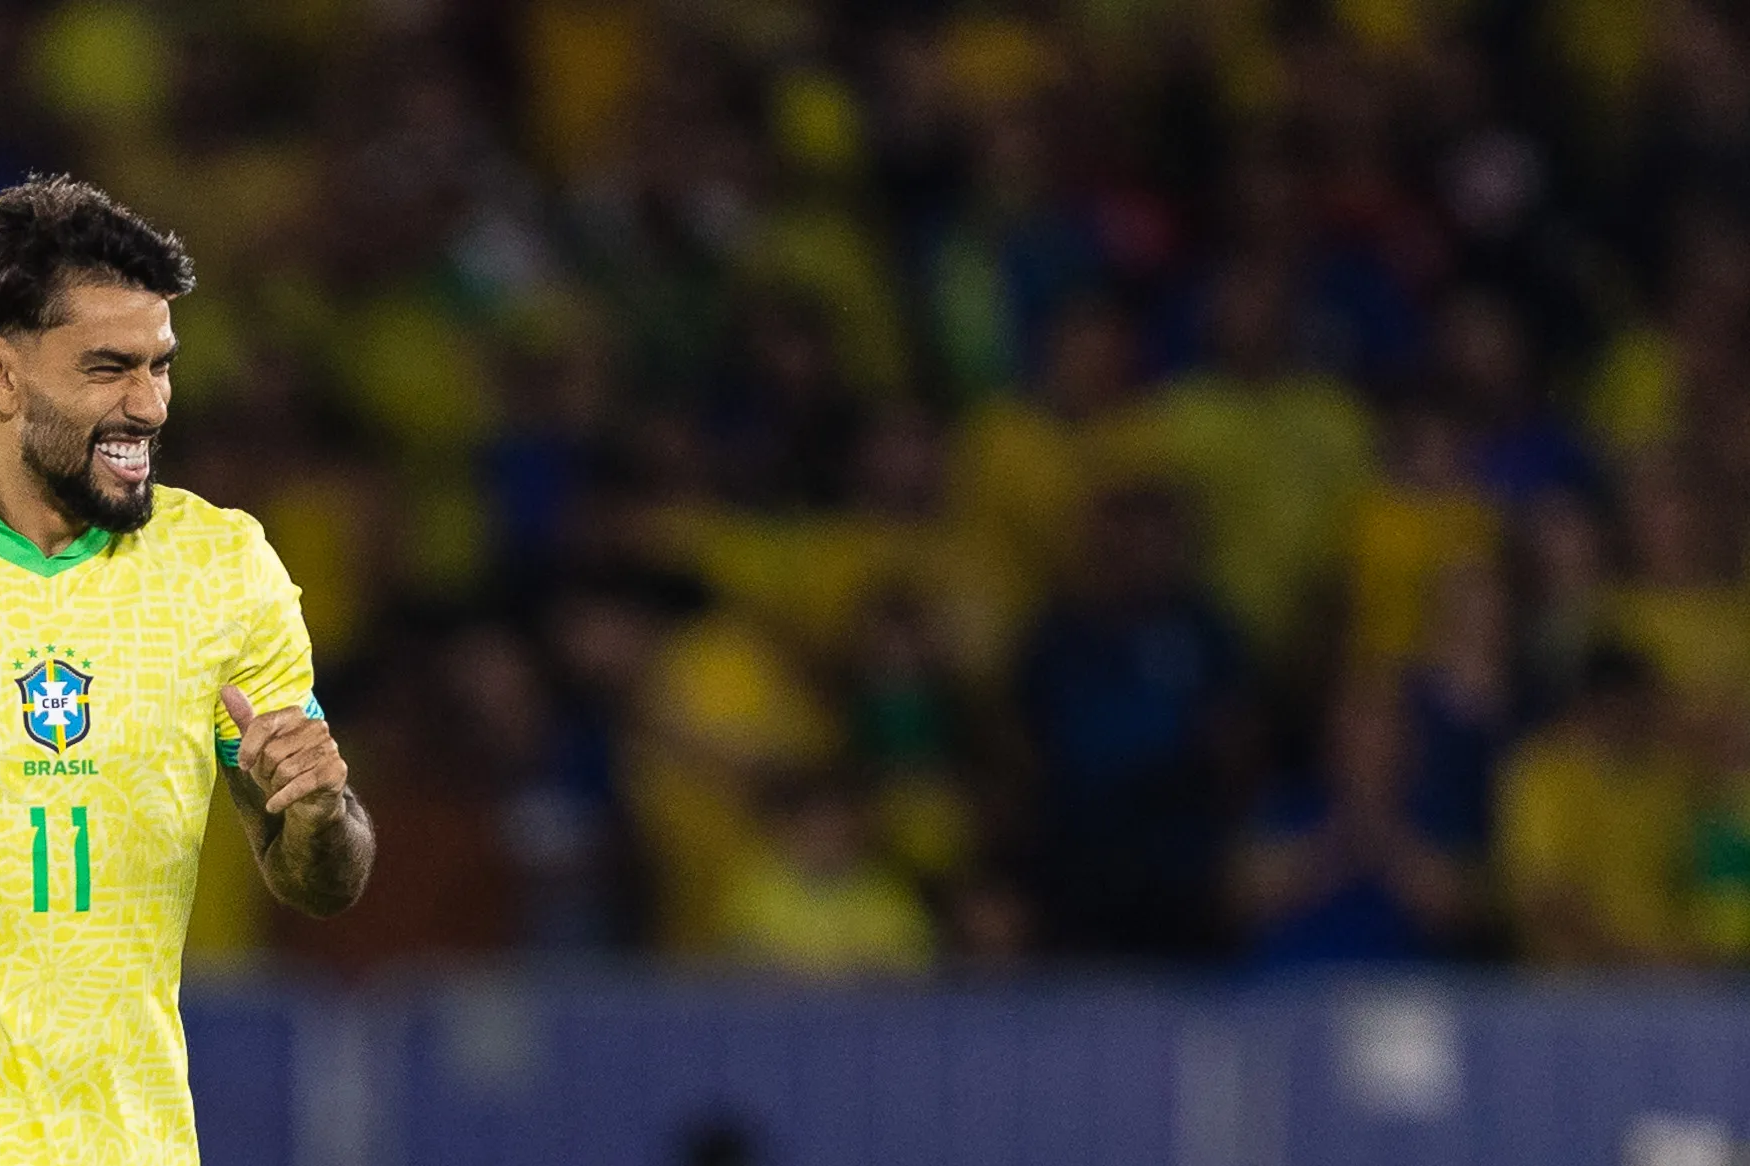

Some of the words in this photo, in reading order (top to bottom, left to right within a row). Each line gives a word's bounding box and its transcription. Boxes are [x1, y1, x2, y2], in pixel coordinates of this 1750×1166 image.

[42, 697, 68, 709] CBF
[24, 760, 98, 776] BRASIL
[30, 806, 90, 912] 11
